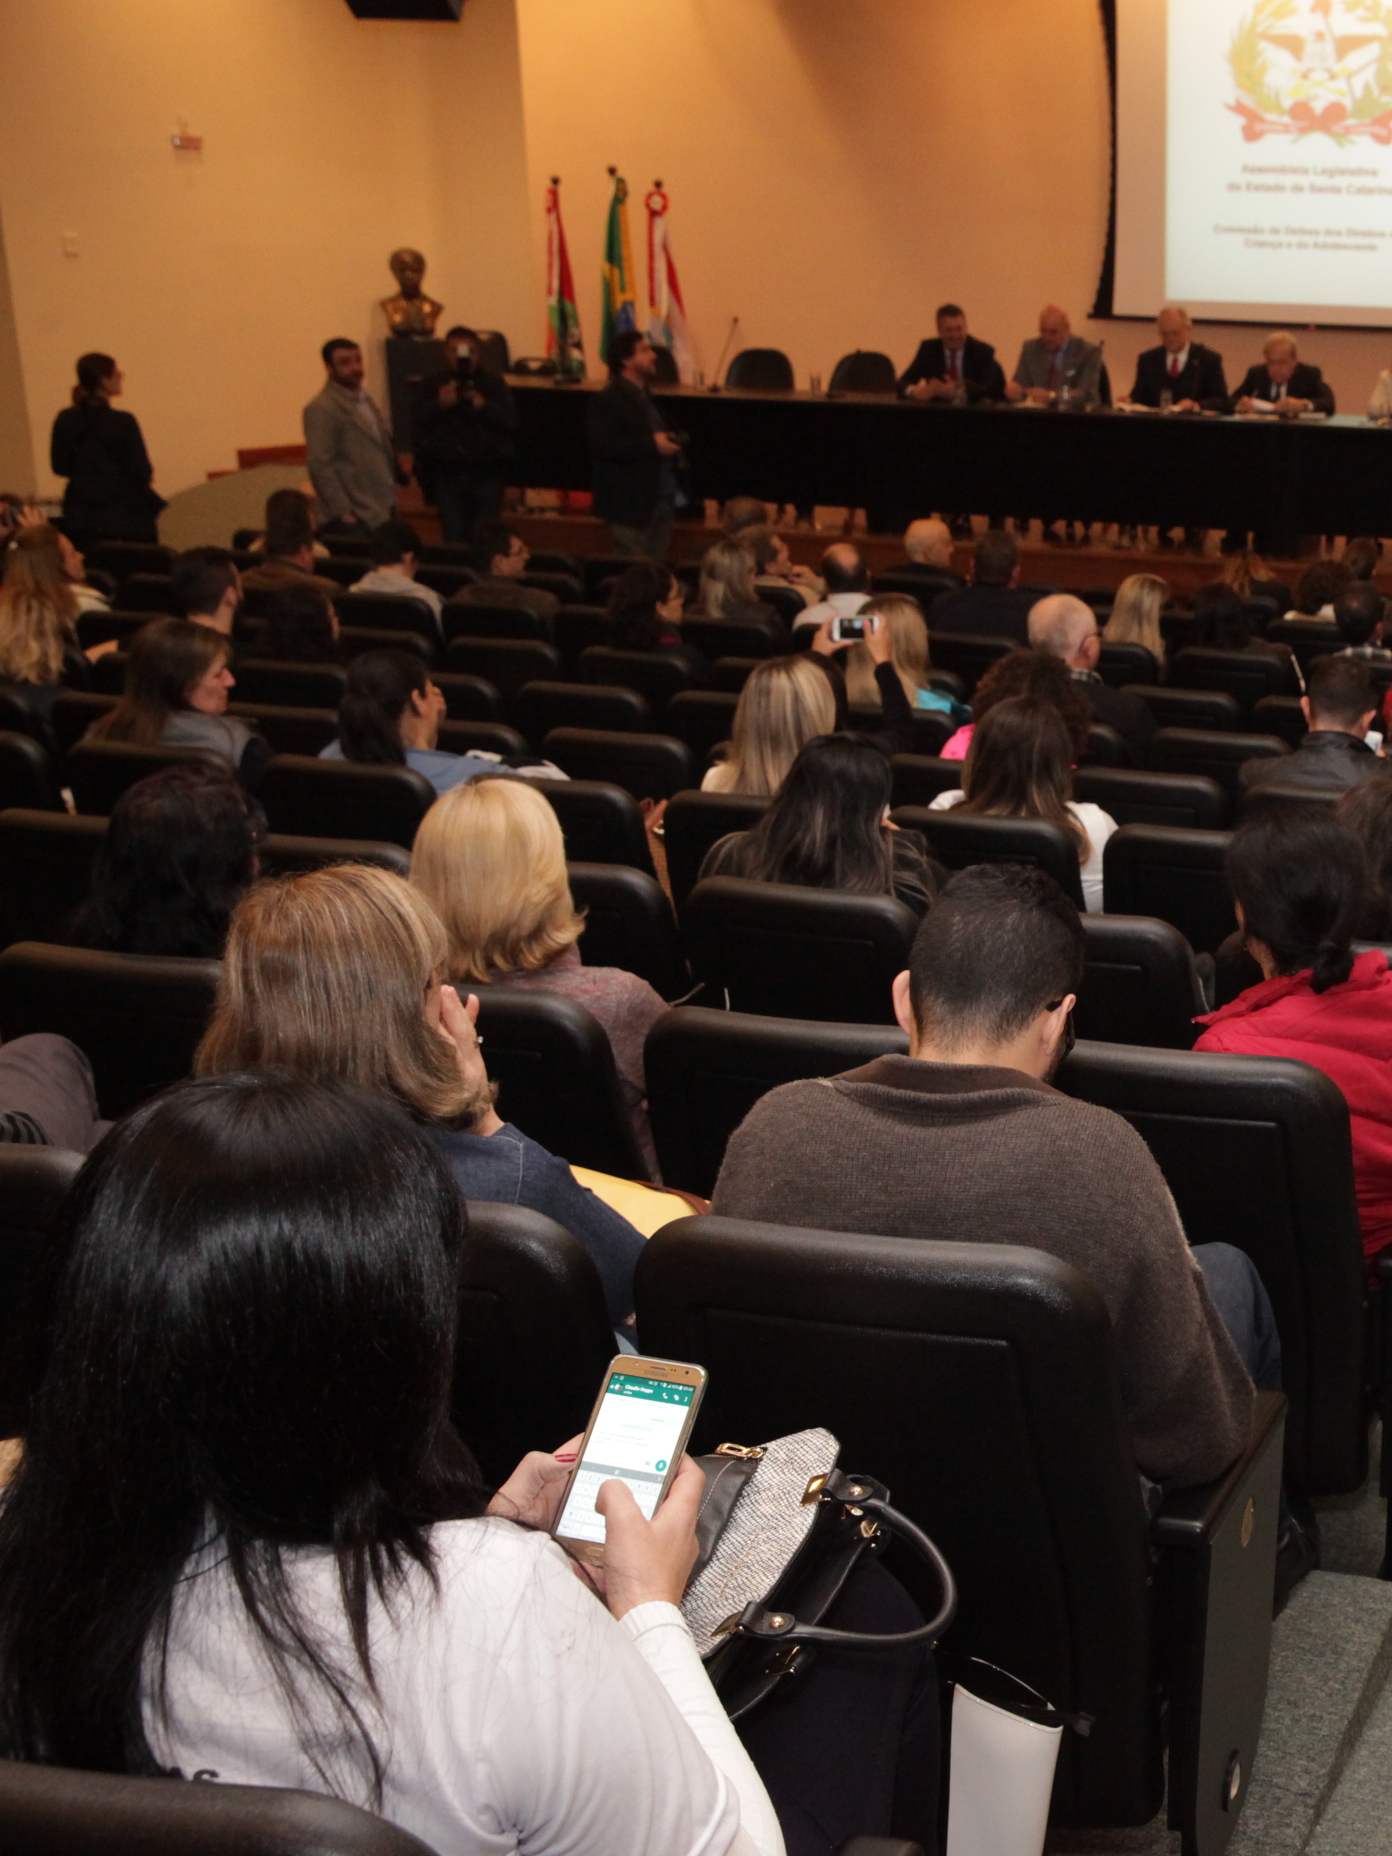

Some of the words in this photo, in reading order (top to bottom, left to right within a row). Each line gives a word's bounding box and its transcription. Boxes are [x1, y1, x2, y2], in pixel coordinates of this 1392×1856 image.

[1313, 165, 1379, 178] Legislativa
[1246, 182, 1286, 192] Estado
[1290, 183, 1305, 193] de
[1309, 183, 1342, 194] Santa
[1312, 241, 1378, 252] Adolescente
